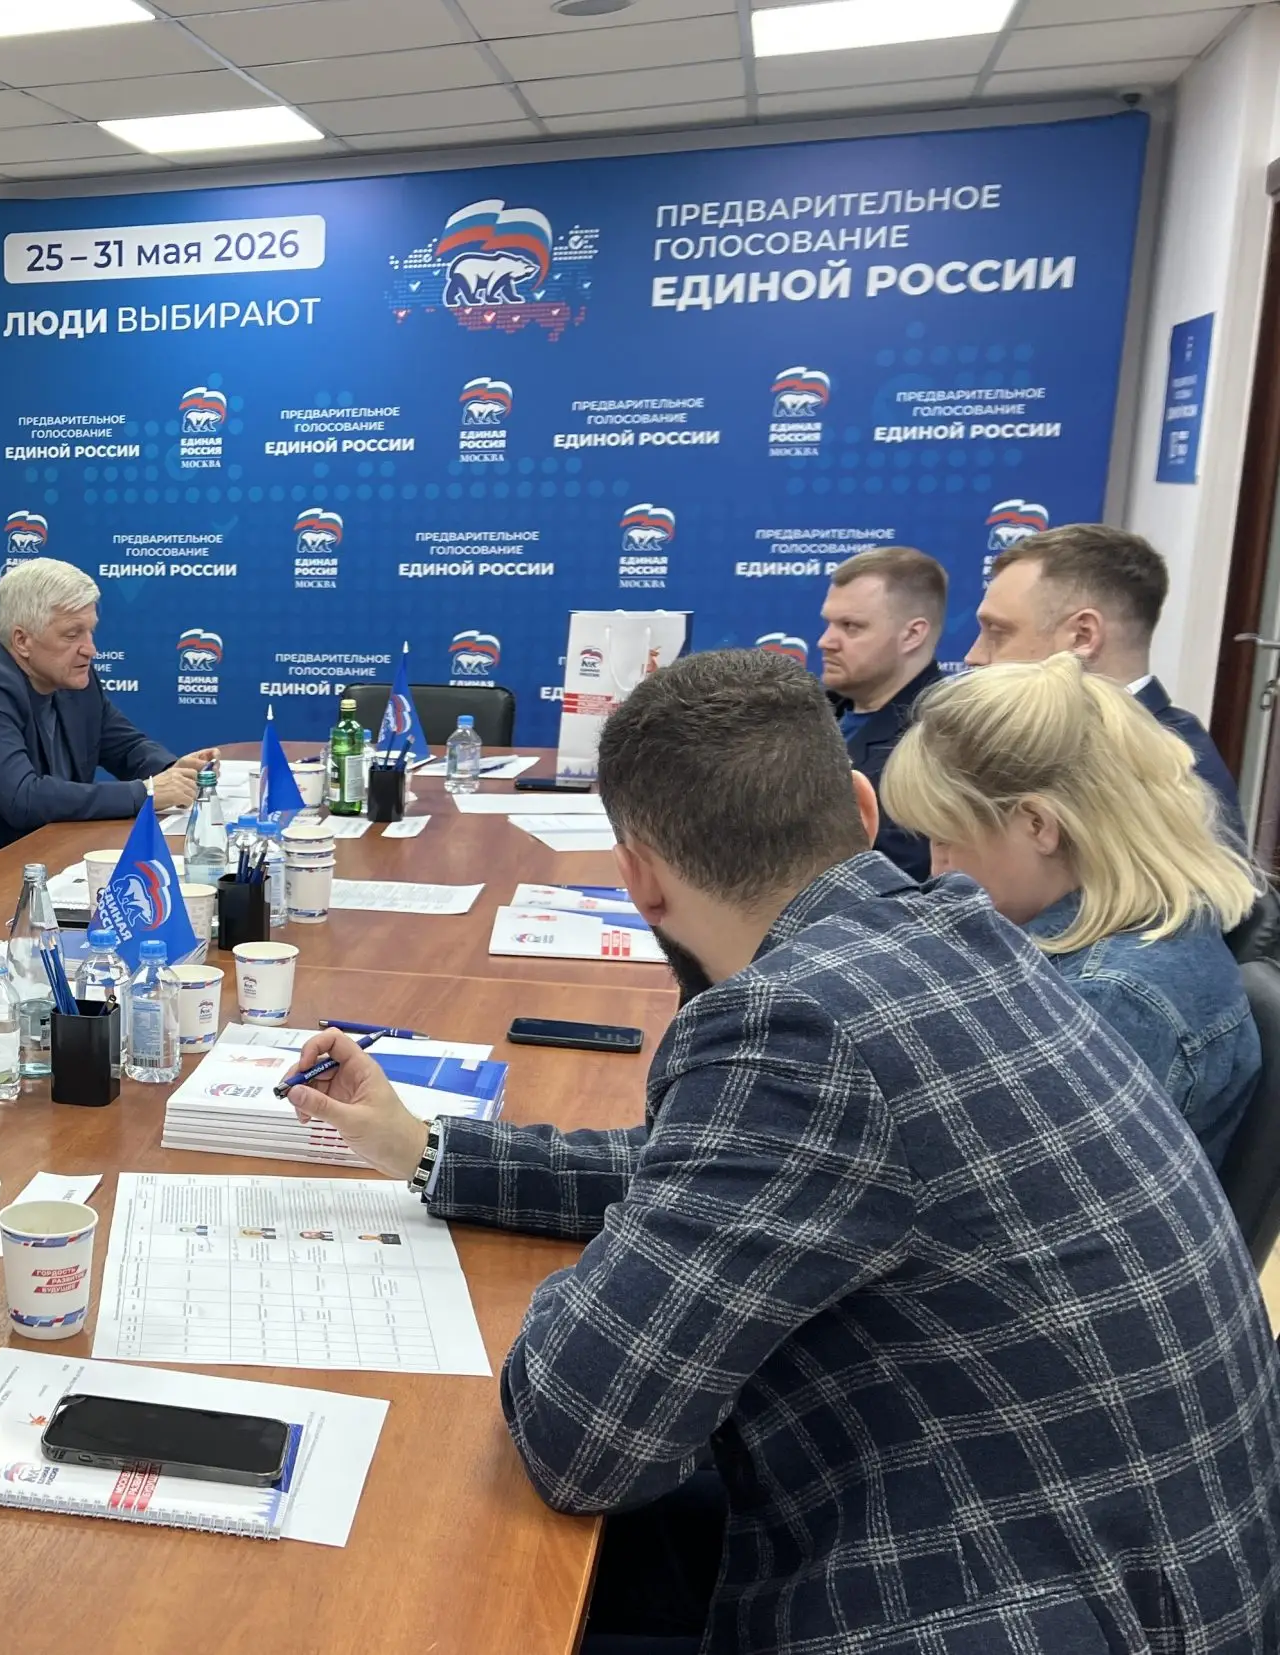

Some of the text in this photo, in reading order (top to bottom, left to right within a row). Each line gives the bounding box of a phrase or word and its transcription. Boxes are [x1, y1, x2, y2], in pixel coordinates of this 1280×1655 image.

[657, 185, 1001, 228] ПРЕДВАРИТЕЛЬНОЕ
[138, 242, 200, 265] мая
[214, 230, 299, 261] 2026
[655, 225, 909, 261] ГОЛОСОВАНИЕ
[652, 257, 1075, 311] ЕДИНОЙ РОССИИ
[4, 298, 321, 339] ЛЮДИ ВЫБИРАЮТ
[896, 388, 1045, 402] ПРЕДВАРИТЕЛЬНОЕ
[572, 398, 704, 411] ПРЕДВАРИТЕЛЬНОЕ
[913, 404, 1025, 416] ГОЛОСОВАНИЕ
[281, 407, 400, 420] ПРЕДВАРИТЕЛЬНОЕ
[587, 413, 686, 424] ГОЛОСОВАНИЕ
[19, 415, 125, 426] ПРЕДВАРИТЕЛЬНОЕ
[295, 422, 384, 432] ГОЛОСОВАНИЕ
[770, 423, 821, 432] ЕДИНАЯ
[874, 422, 1061, 442] ЕДИНОЙ РОССИИ
[32, 429, 112, 438] ГОЛОСОВАНИЕ
[460, 430, 506, 439] ЕДИНАЯ
[769, 431, 820, 442] РОССИЯ
[181, 438, 222, 448] ЕДИНАЯ
[460, 438, 505, 448] РОССИЯ
[554, 430, 719, 449] ЕДИНОЙ РОССИИ
[6, 444, 139, 460] ЕДИНОЙ РОССИИ
[181, 447, 222, 455] РОССИЯ
[265, 438, 414, 455] ЕДИНОЙ РОССИИ
[770, 448, 818, 456] МОСКВА
[460, 454, 504, 462] МОСКВА
[182, 460, 221, 468] МОСКВА
[113, 535, 222, 544] ПРЕДВАРИТЕЛЬНОЕ
[416, 531, 539, 542] ПРЕДВАРИТЕЛЬНОЕ
[756, 529, 894, 540] ПРЕДВАРИТЕЛЬНОЕ
[126, 548, 209, 556] ГОЛОСОВАНИЕ
[430, 546, 523, 555] ГОЛОСОВАНИЕ
[620, 557, 667, 565] ЕДИНАЯ
[100, 562, 236, 578] ЕДИНОЙ РОССИИ
[295, 567, 337, 575] РОССИЯ
[399, 561, 553, 577] ЕДИНОЙ РОССИИ
[619, 564, 667, 574] РОССИЯ
[736, 559, 820, 577] ЕДИНОЙ
[620, 580, 665, 588] МОСКВА
[276, 654, 390, 663] ПРЕДВАРИТЕЛЬНОЕ
[289, 667, 376, 676] ГОЛОСОВАНИЕ
[178, 676, 218, 684] ЕДИНАЯ
[261, 681, 330, 696] ЕДИНОЙ
[179, 695, 217, 704] МОСКВА
[105, 885, 133, 941] ЕДИНАЯ
[36, 1268, 76, 1277] ГОРДОСТЬ
